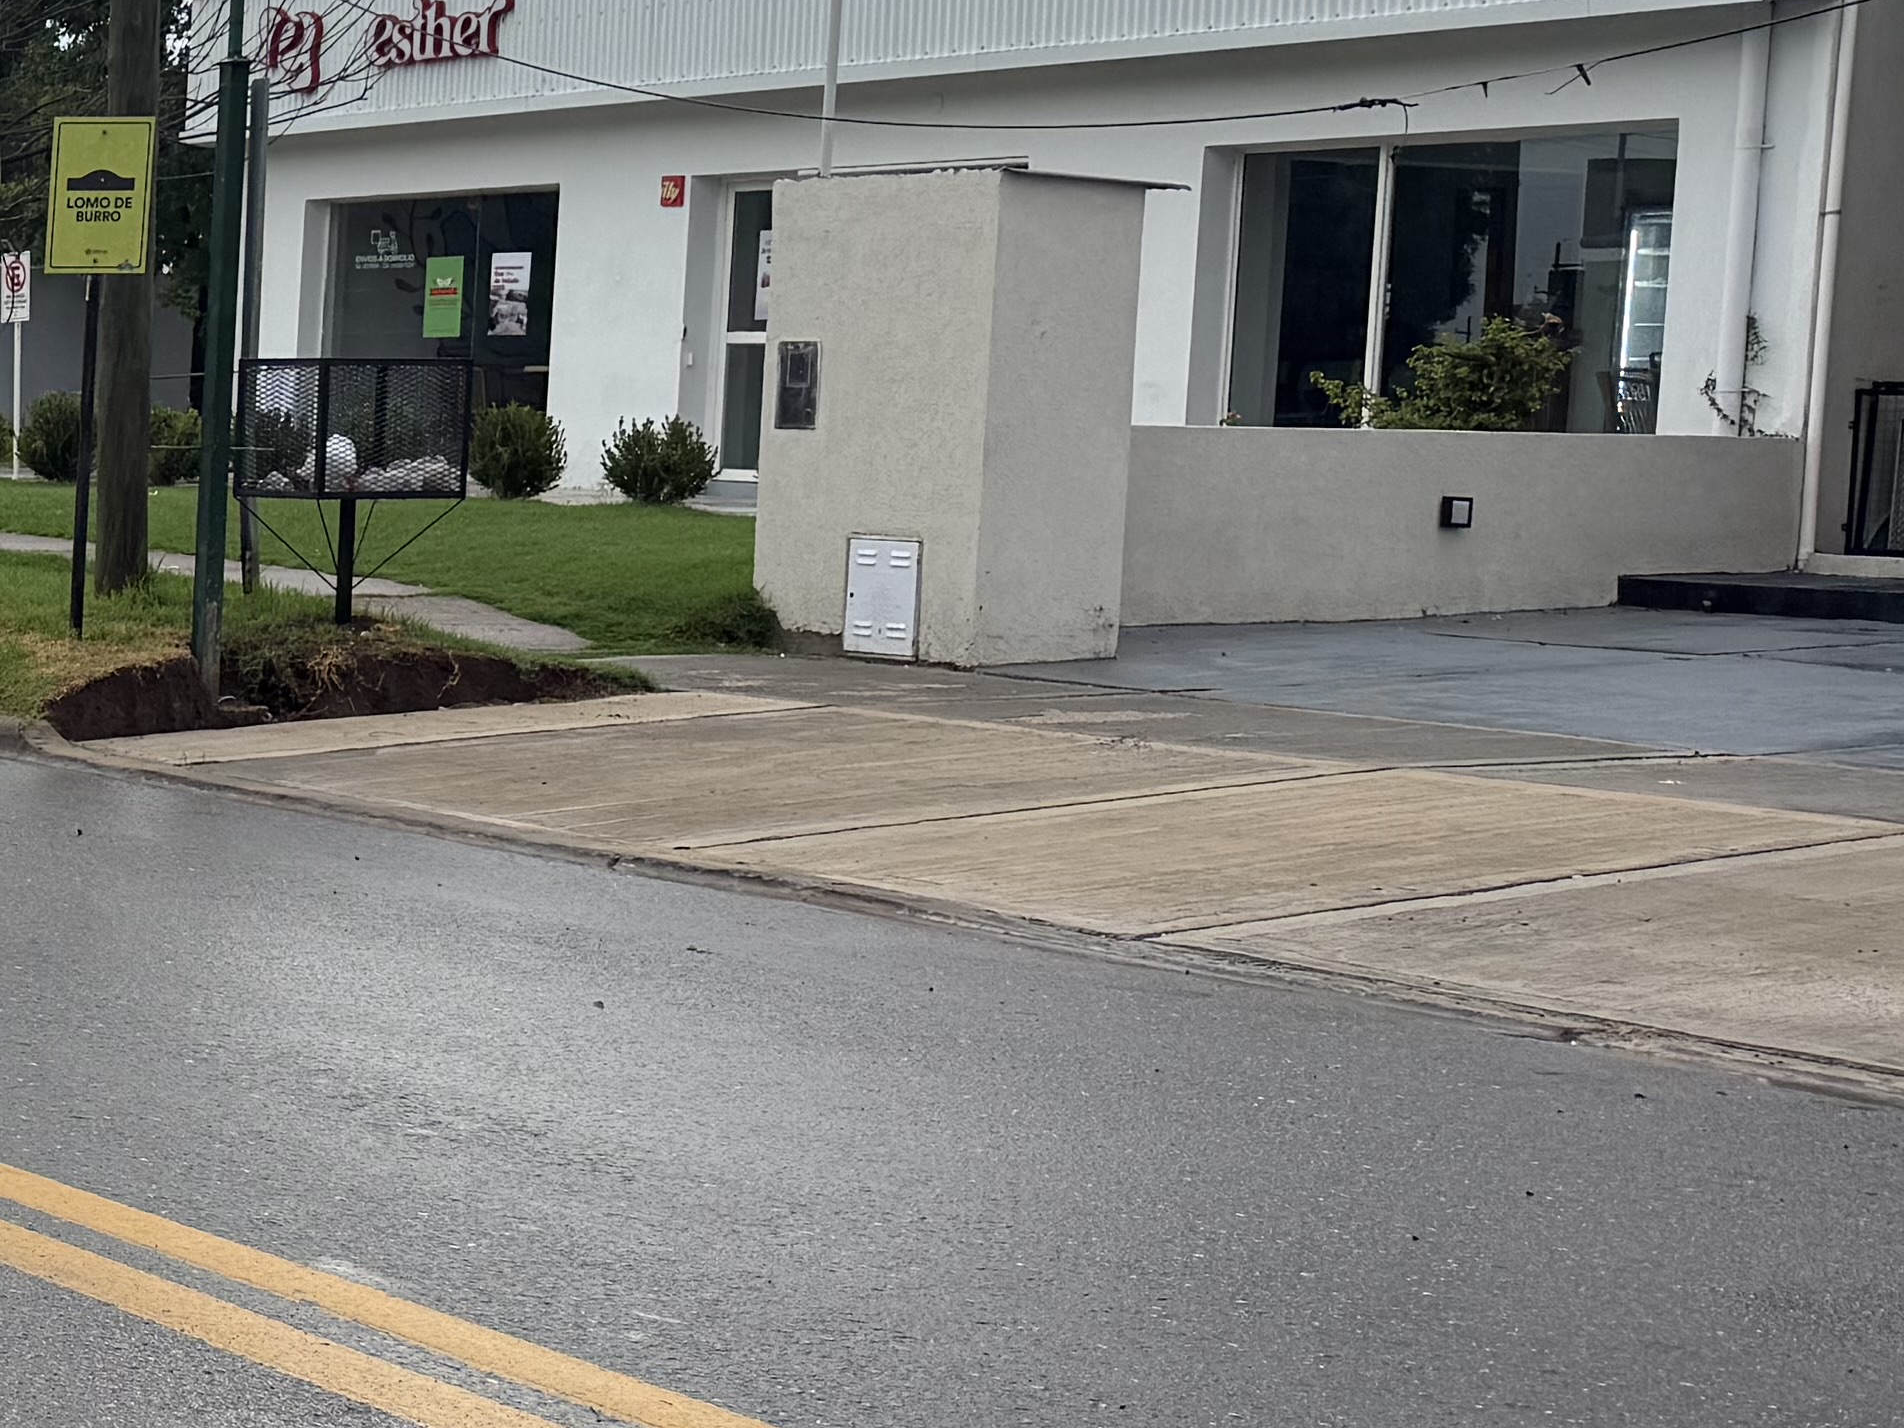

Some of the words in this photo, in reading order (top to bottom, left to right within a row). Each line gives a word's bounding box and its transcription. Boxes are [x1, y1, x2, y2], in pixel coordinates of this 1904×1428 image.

[67, 197, 111, 209] LOMO
[114, 197, 133, 209] DE
[76, 210, 122, 222] BURRO
